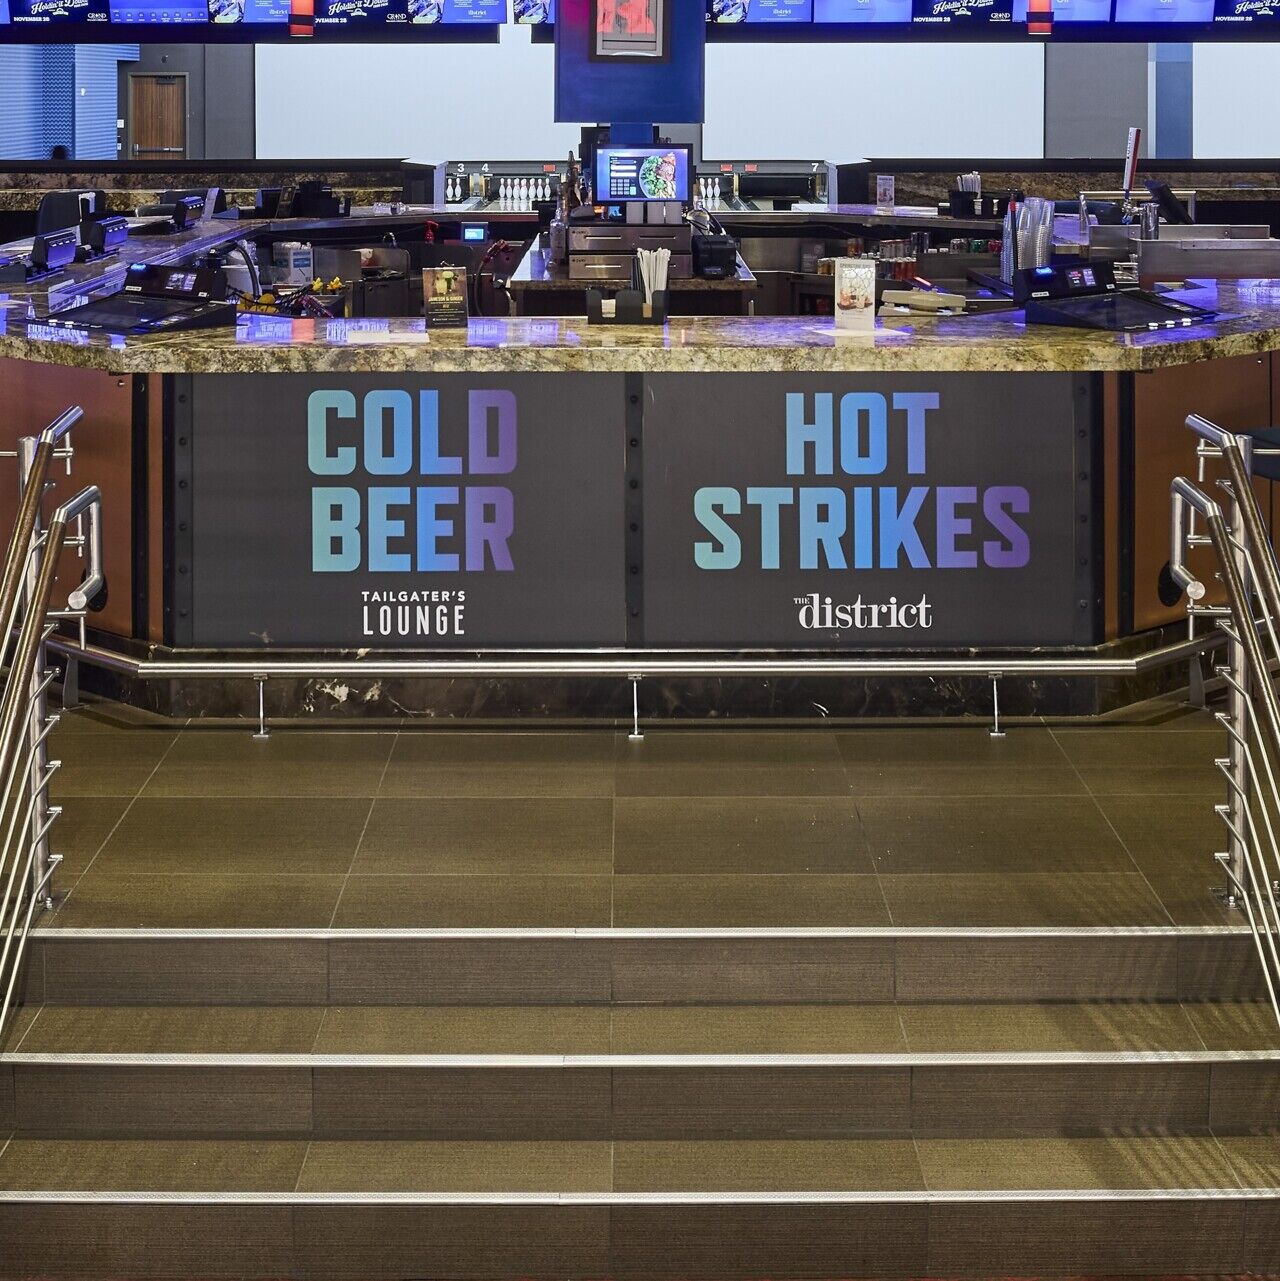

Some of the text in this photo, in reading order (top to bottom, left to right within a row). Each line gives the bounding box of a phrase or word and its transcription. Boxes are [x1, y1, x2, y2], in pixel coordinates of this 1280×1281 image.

[457, 163, 464, 172] 3
[481, 163, 489, 172] 4
[811, 163, 819, 172] 7
[307, 389, 517, 476] COLD
[785, 392, 941, 475] HOT
[312, 485, 515, 572] BEER
[693, 484, 1032, 570] STRIKES
[361, 590, 467, 603] TAILGATER'S
[798, 593, 933, 629] district
[363, 606, 465, 636] LOUNGE
